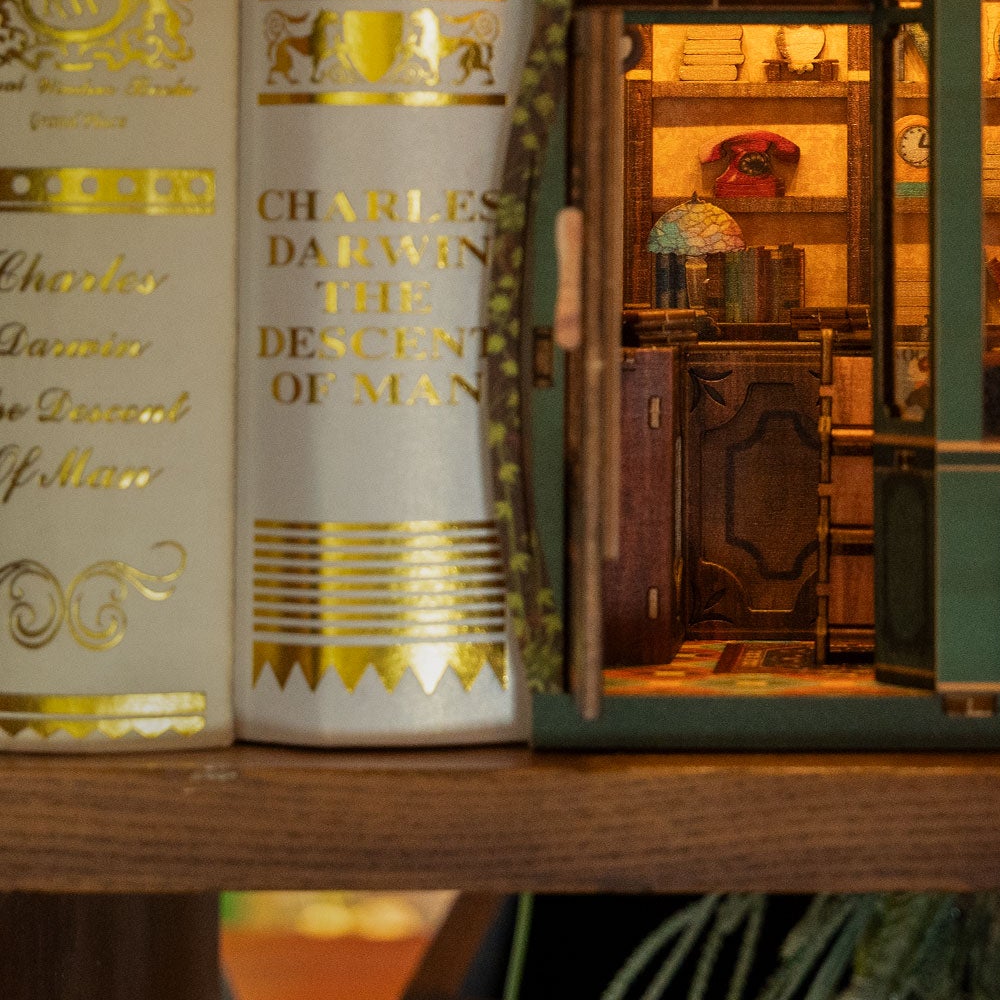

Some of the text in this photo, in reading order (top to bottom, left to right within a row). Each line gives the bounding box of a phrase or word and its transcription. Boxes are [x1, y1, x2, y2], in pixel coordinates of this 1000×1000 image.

[257, 188, 500, 224] CHARLES
[268, 234, 490, 269] DARWIN
[0, 250, 170, 294] Charles
[314, 280, 432, 315] THE
[37, 387, 192, 424] Descent
[271, 371, 484, 407] OF MAN
